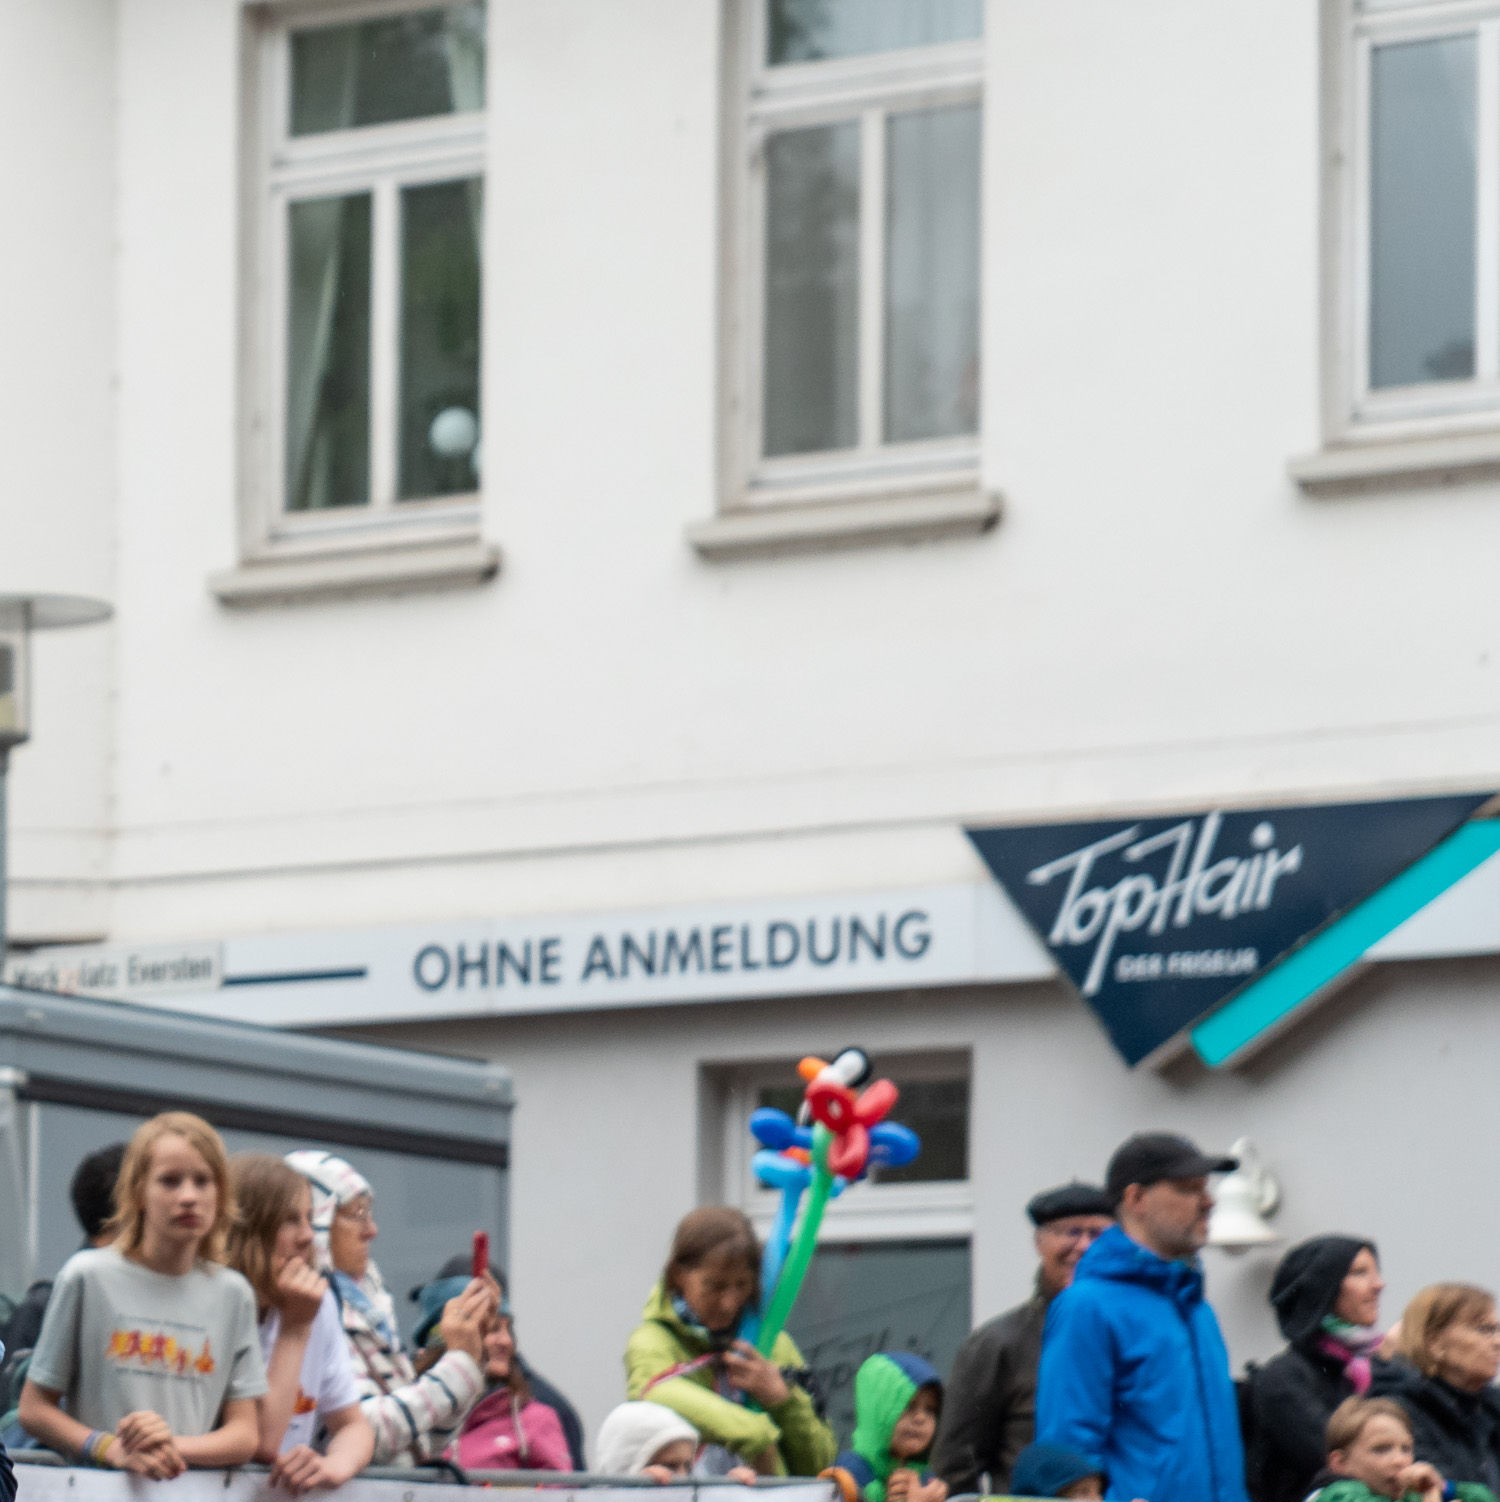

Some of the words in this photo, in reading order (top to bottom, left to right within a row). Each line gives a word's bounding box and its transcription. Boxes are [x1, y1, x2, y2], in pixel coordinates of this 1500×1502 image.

[1027, 810, 1302, 997] TopHair
[412, 935, 563, 993] OHNE
[580, 909, 933, 983] ANMELDUNG
[1115, 954, 1163, 983] DER
[1166, 948, 1258, 979] FRISEUR
